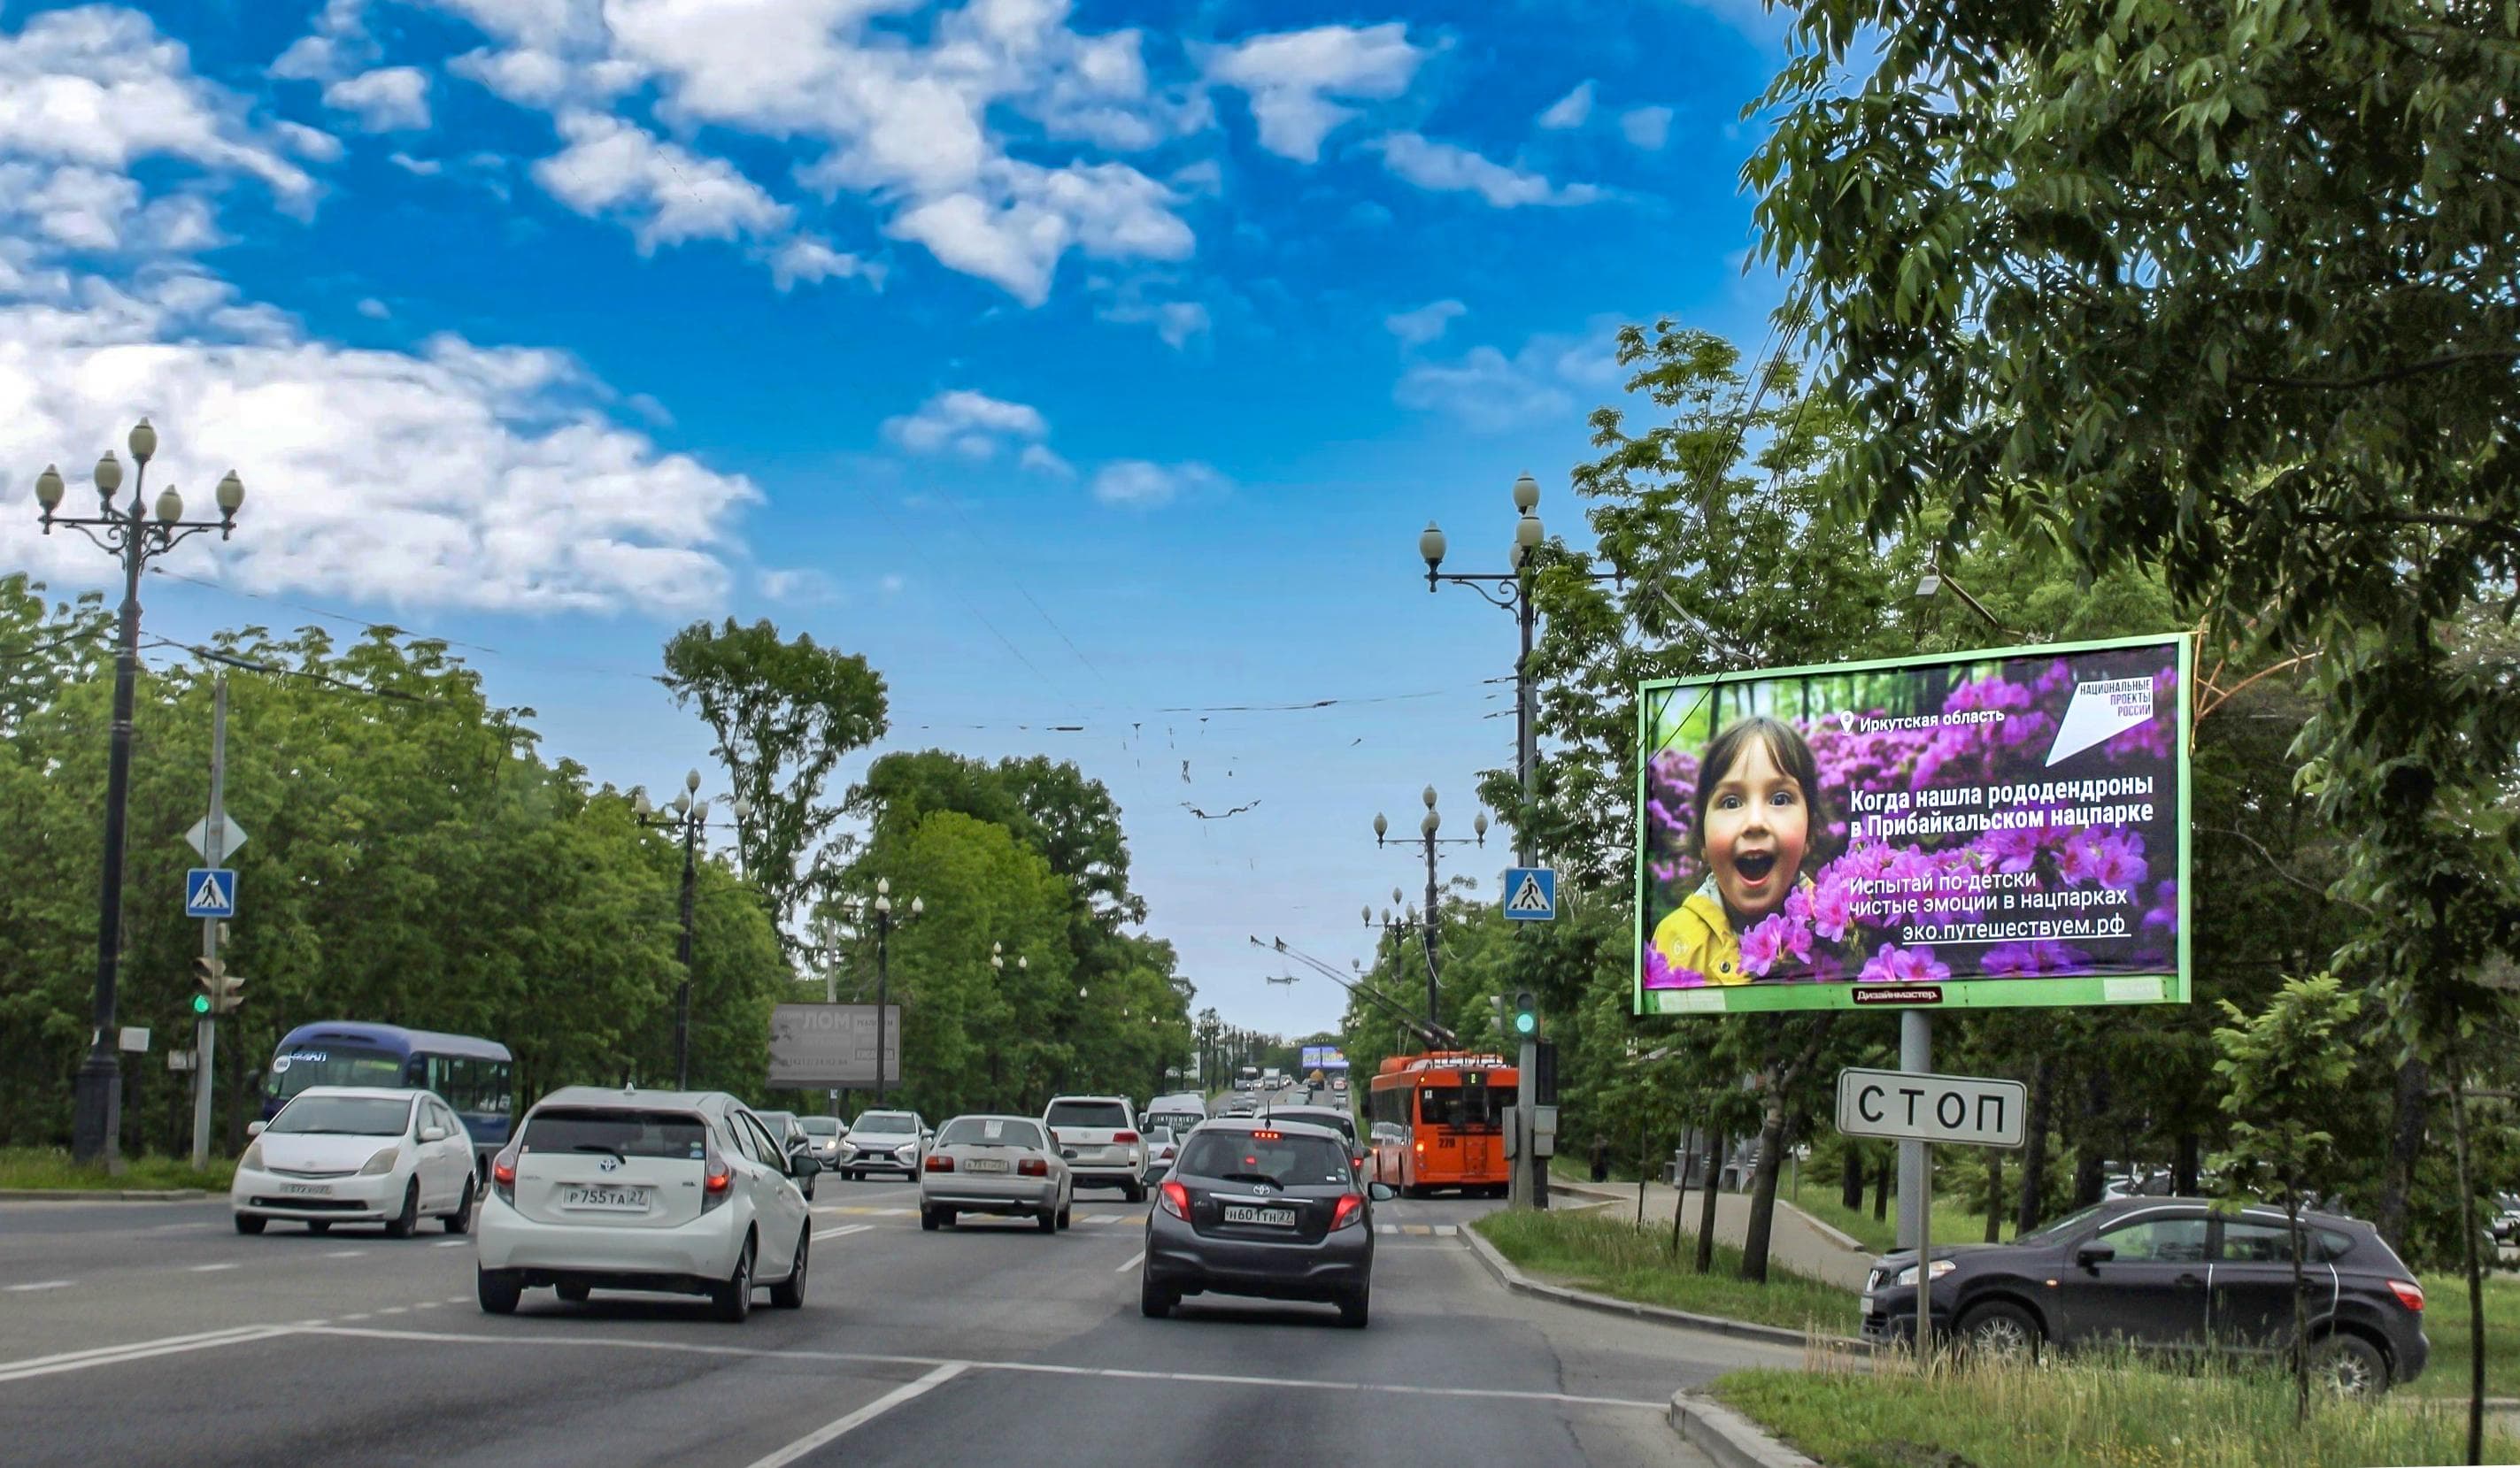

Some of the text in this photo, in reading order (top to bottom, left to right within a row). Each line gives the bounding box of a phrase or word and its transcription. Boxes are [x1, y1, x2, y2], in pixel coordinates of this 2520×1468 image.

[2080, 679, 2151, 696] НАЦИОНАЛЬНЫЕ
[2110, 692, 2151, 705] ПРОЕКТЫ
[1860, 710, 2005, 734] Иркутская область
[2117, 704, 2151, 717] РОССИИ
[1851, 776, 2154, 814] Когда нашла рододендроны
[1851, 803, 2154, 841] в Прибайкальском нацпарке
[1849, 872, 2037, 895] Испытай по-детски
[1849, 889, 2128, 916] чистые эмоции в нацпарках
[1903, 912, 2125, 942] эко.путешествуем.рф
[803, 1011, 851, 1030] ЛОМ
[1859, 1085, 2005, 1133] СТОП
